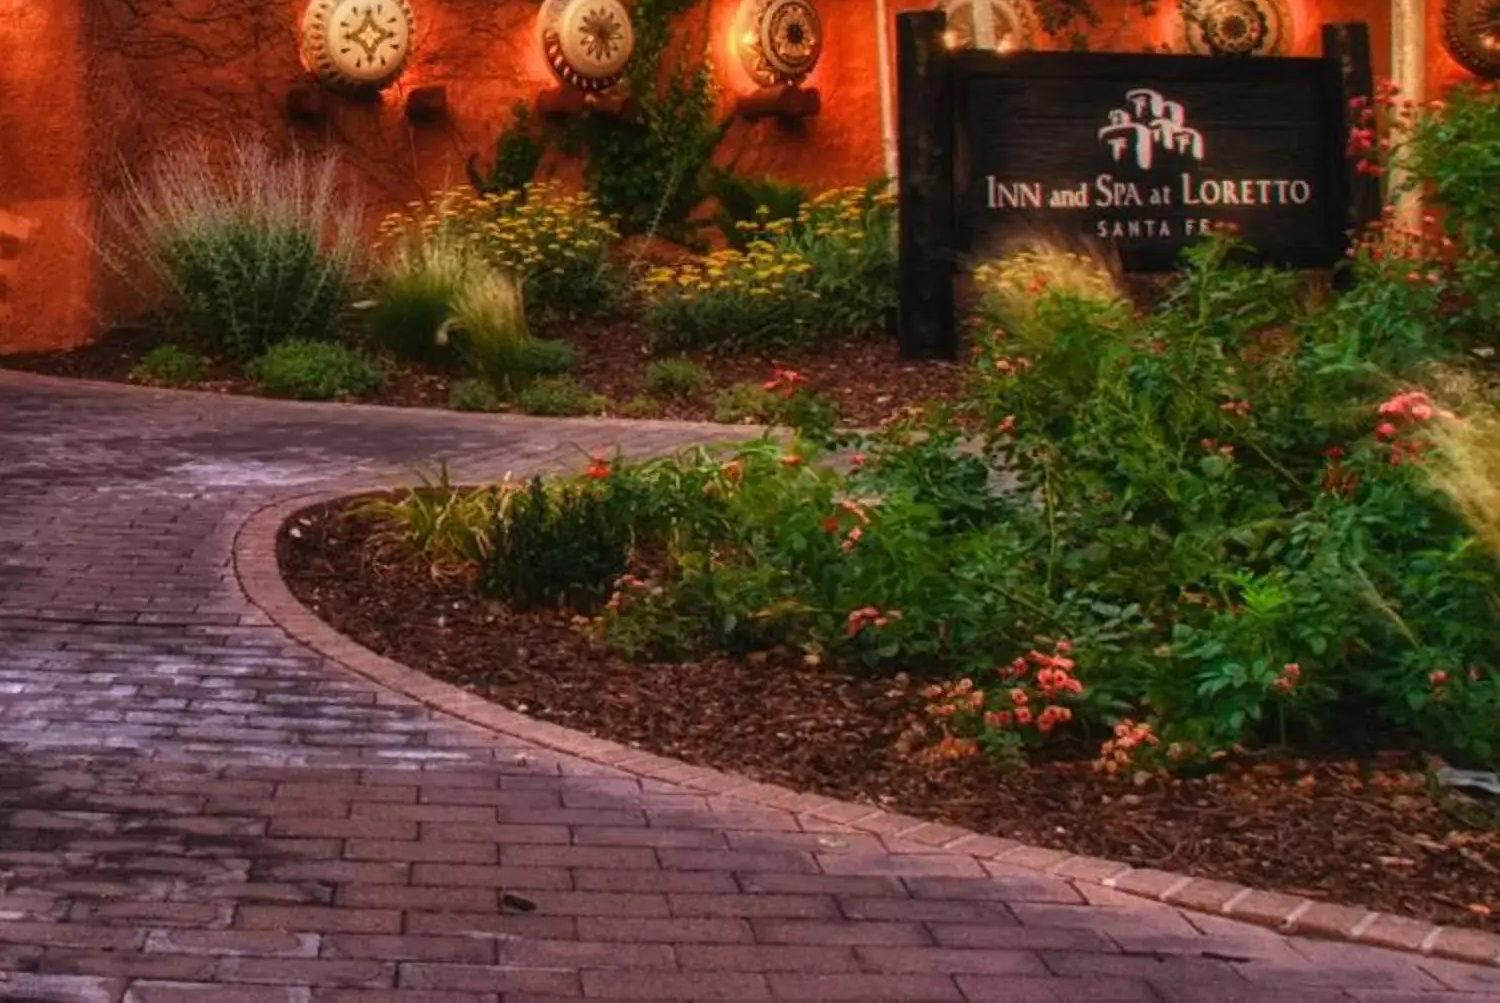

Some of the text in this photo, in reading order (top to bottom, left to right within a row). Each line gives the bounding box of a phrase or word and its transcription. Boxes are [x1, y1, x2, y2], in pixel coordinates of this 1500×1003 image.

[987, 172, 1310, 208] INN and SPA at LORETTO
[1097, 218, 1211, 237] SANTA FE
